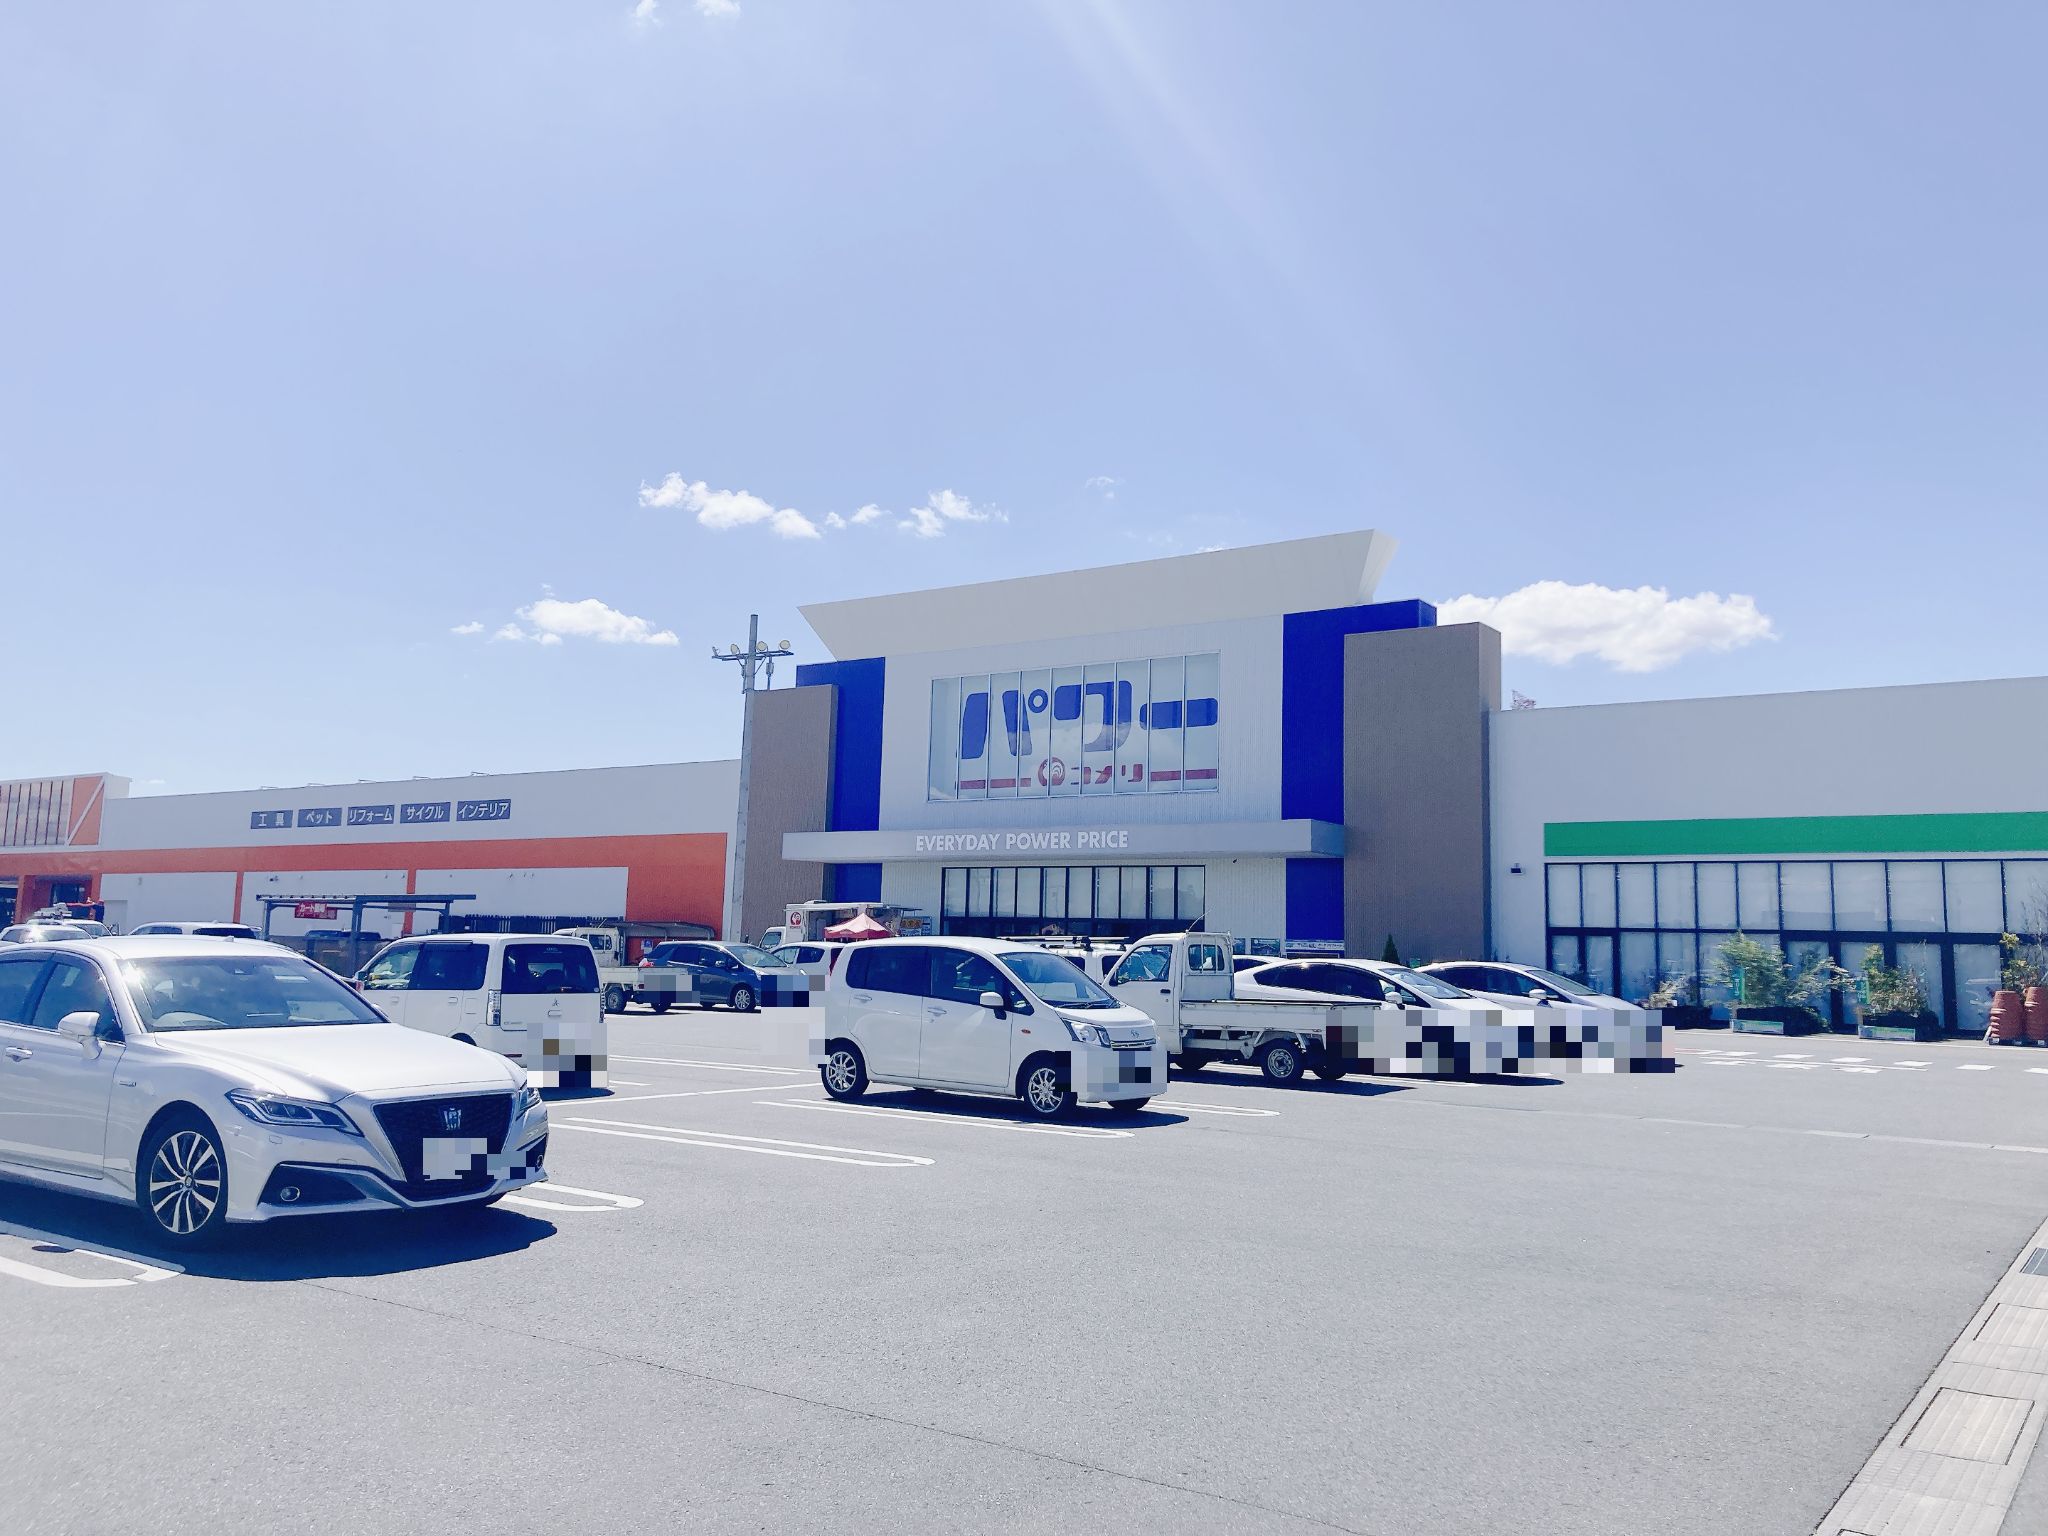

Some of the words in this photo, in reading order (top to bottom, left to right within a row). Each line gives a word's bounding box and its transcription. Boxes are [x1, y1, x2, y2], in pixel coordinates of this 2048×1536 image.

[959, 680, 1219, 760] パワー
[1070, 763, 1144, 786] コメリ
[258, 812, 285, 827] 工具
[305, 810, 333, 824] ペット
[348, 807, 393, 823] リフォーム
[406, 805, 445, 821] サイクル
[457, 802, 509, 820] インテリア
[915, 833, 1001, 852] EVERYDAY
[1005, 832, 1072, 850] POWER
[1076, 830, 1129, 849] PRICE
